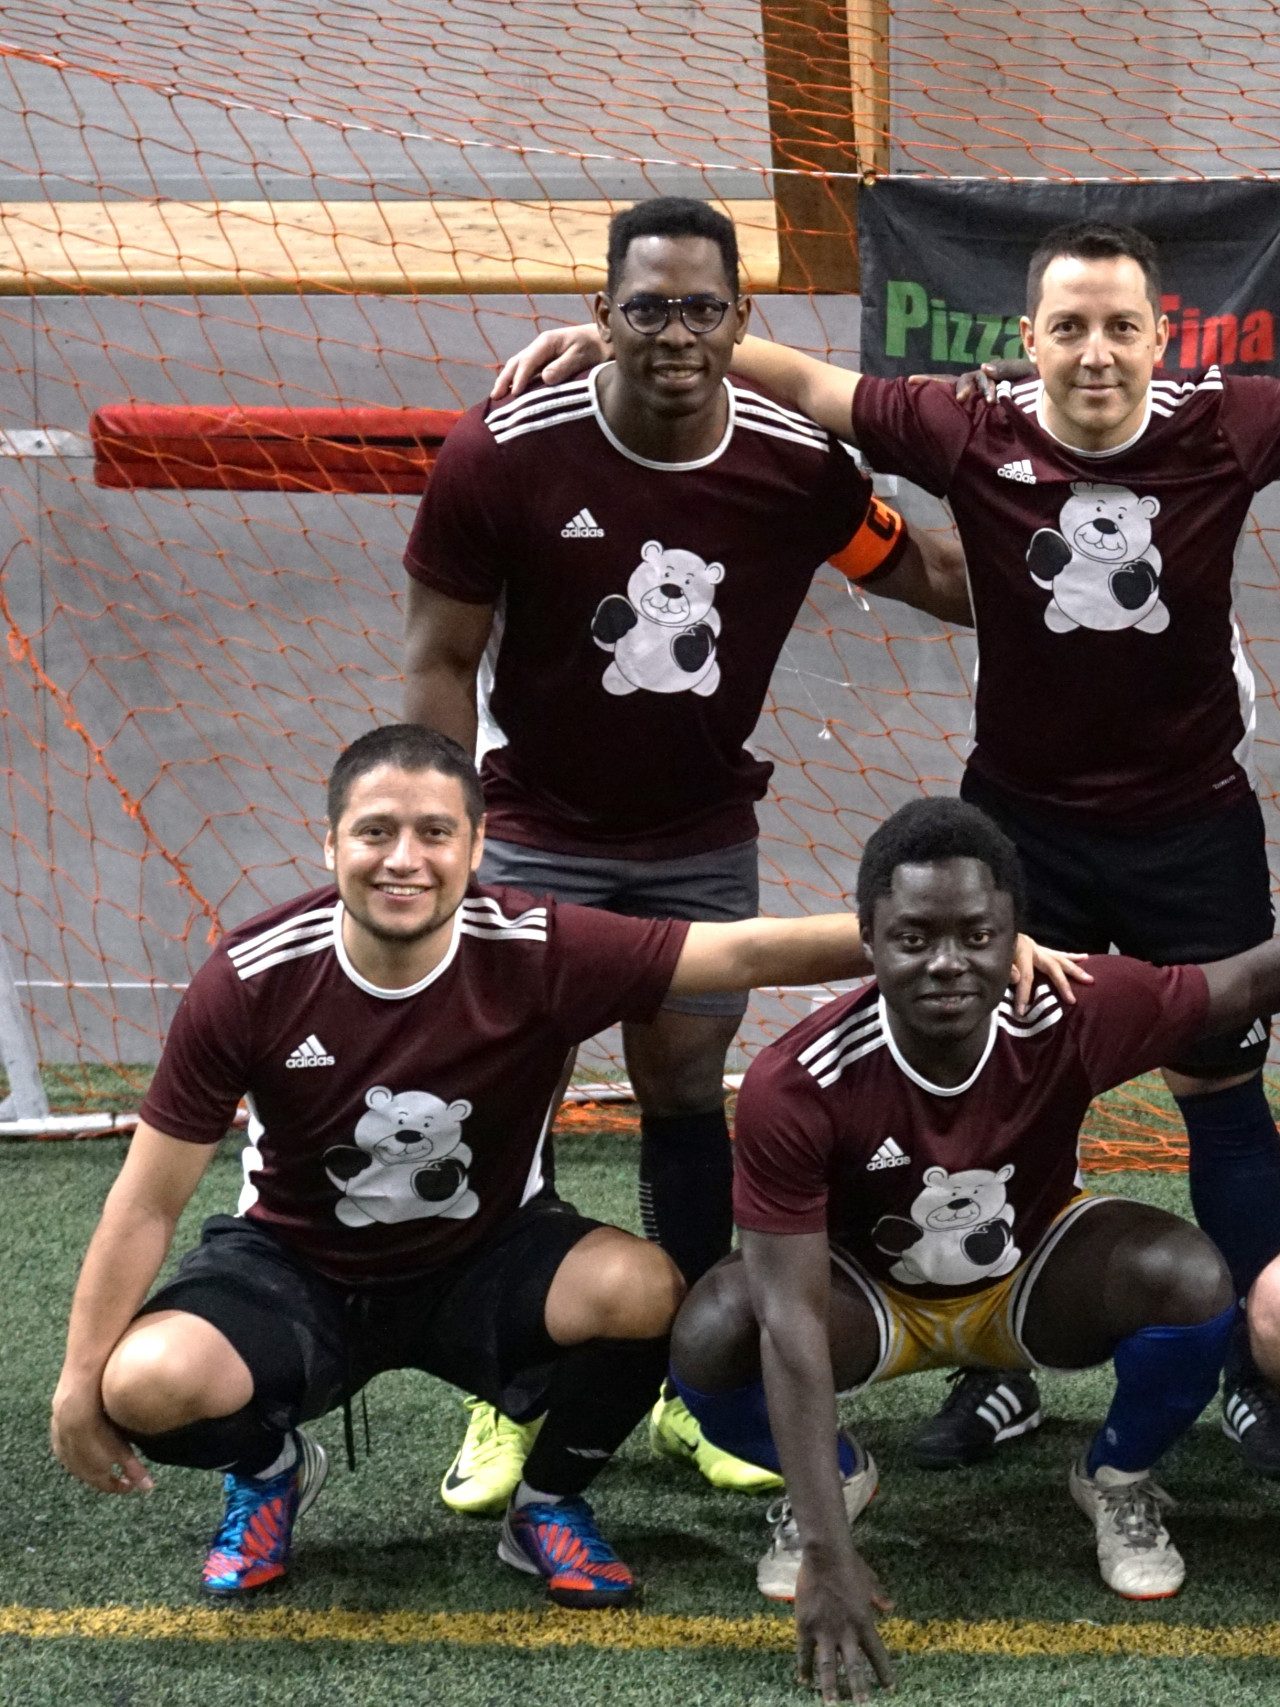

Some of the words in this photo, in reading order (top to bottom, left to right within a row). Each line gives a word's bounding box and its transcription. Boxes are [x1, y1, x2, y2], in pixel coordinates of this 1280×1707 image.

[885, 280, 1025, 363] Pizza
[1153, 293, 1275, 368] ina
[996, 467, 1037, 485] adidas
[560, 527, 605, 538] adidas
[285, 1055, 336, 1069] adidas
[866, 1156, 911, 1171] adidas
